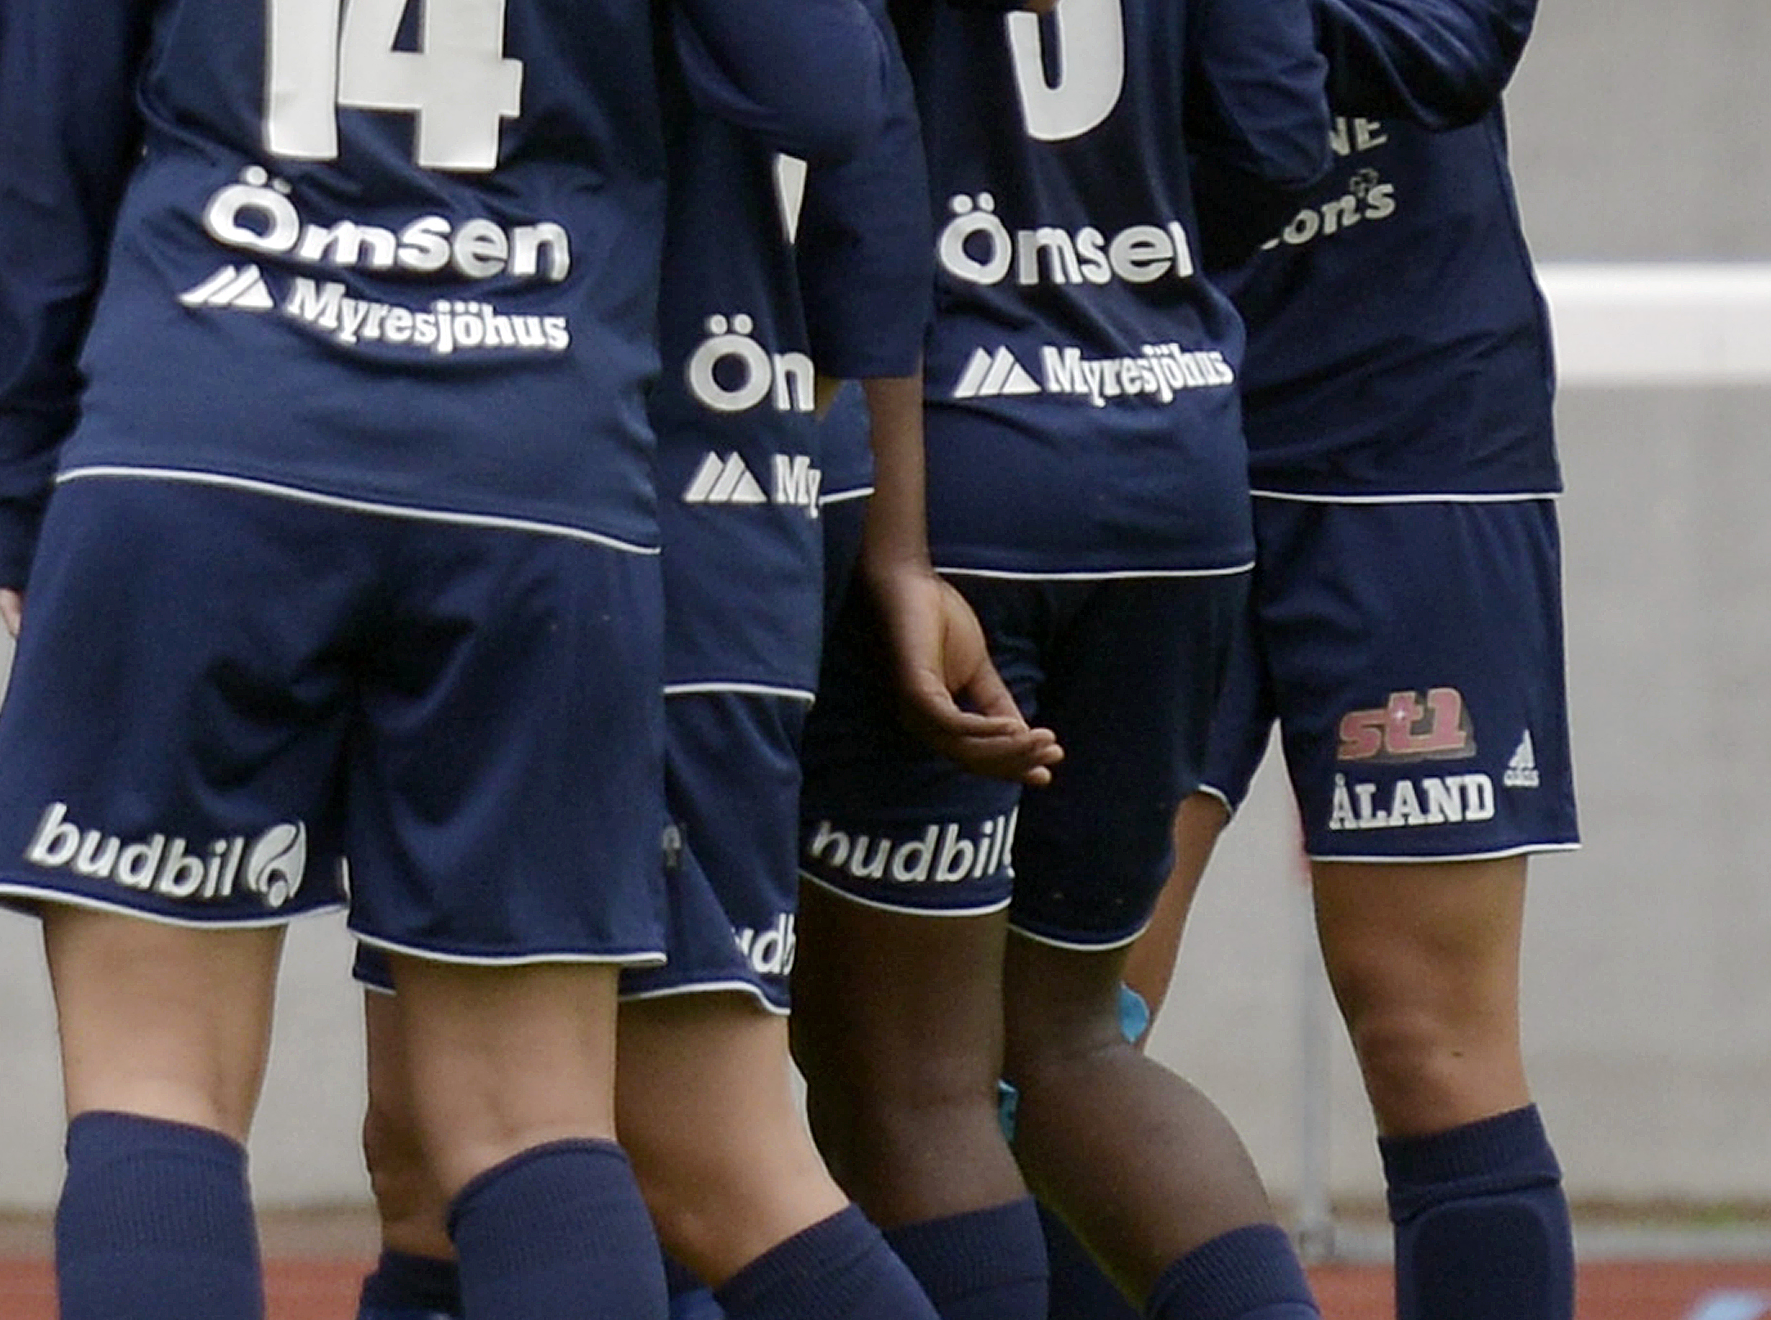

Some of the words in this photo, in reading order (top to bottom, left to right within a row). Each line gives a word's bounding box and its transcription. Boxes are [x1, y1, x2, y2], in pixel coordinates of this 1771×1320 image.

[200, 165, 571, 281] Ömsen
[284, 274, 570, 354] Myresjöhus
[1039, 342, 1234, 407] Myresjöhus
[1336, 686, 1476, 763] st1
[1329, 772, 1495, 830] ÅLAND
[26, 802, 247, 901] budbil
